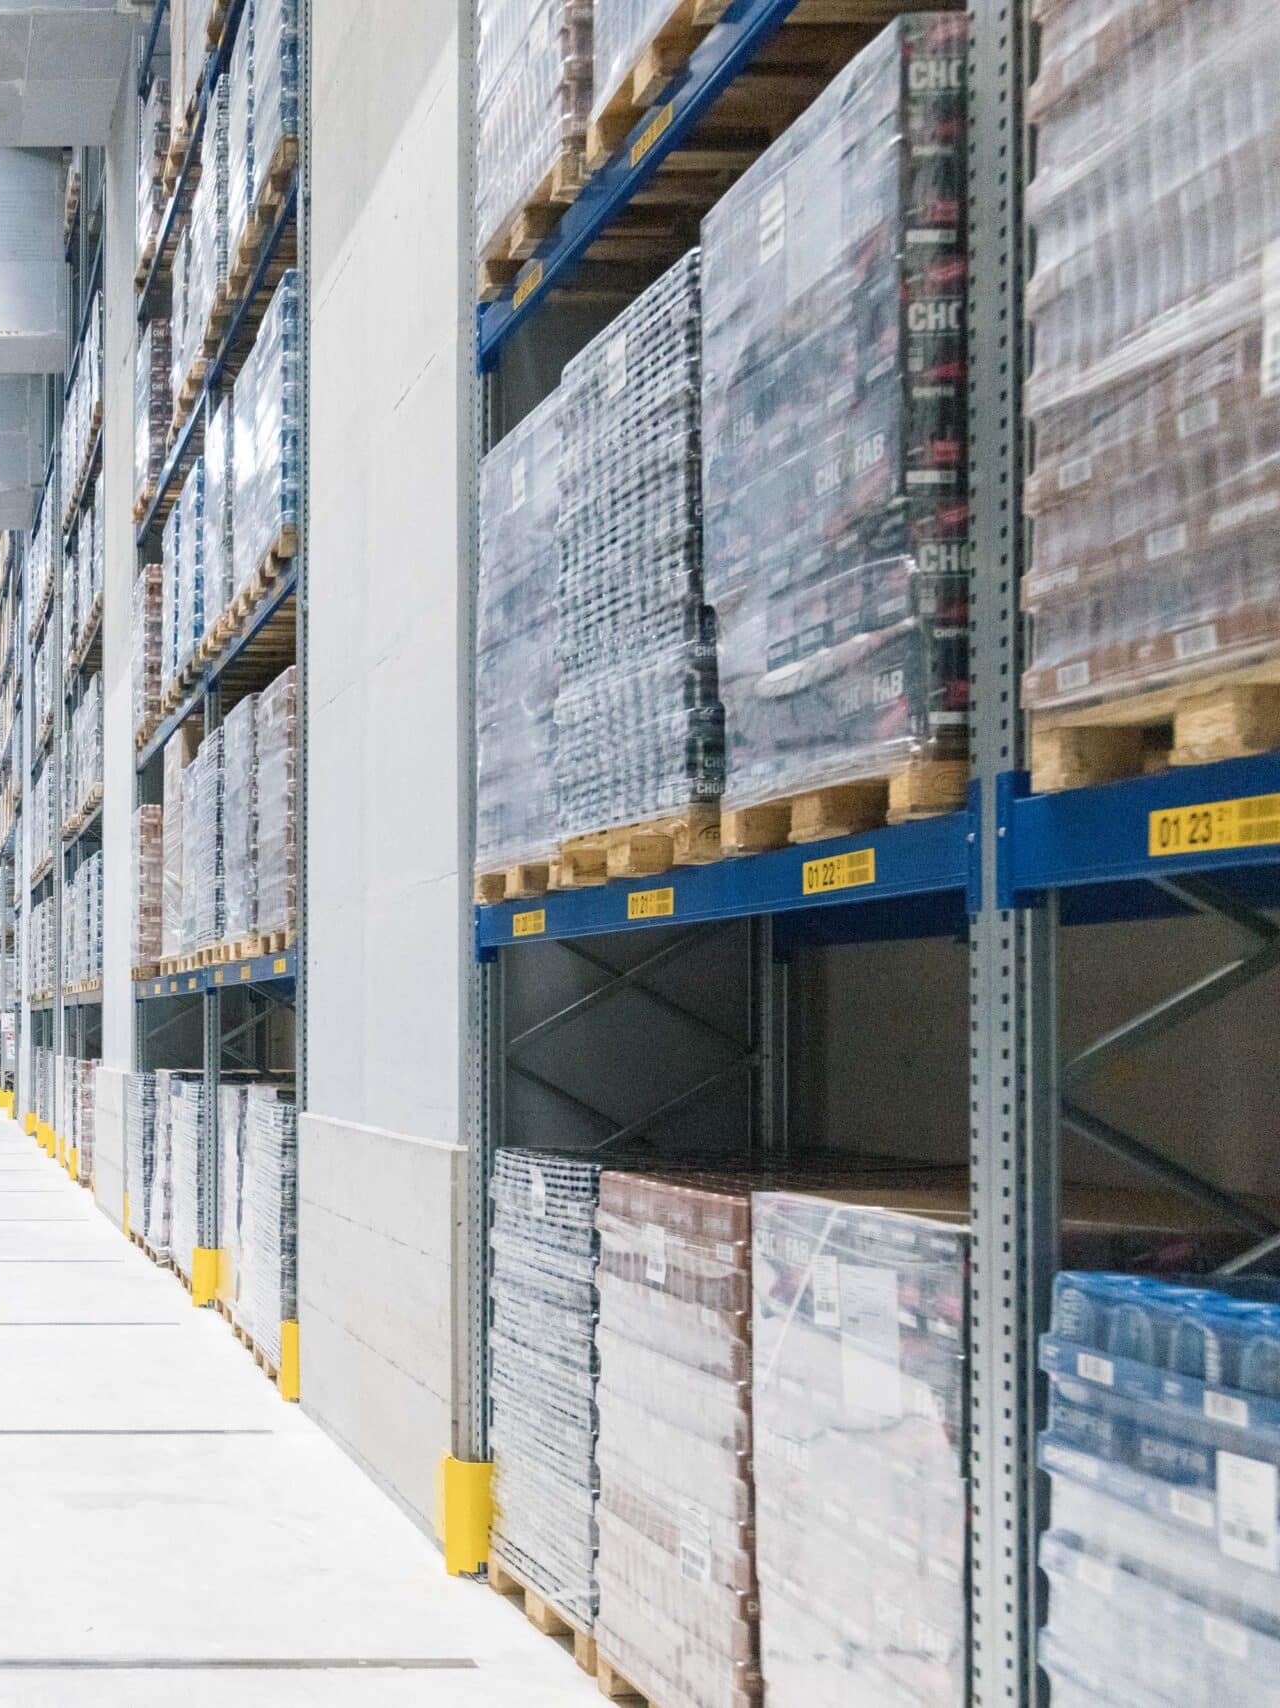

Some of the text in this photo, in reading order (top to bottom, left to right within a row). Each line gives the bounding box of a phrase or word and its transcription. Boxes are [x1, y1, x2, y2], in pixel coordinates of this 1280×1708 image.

[1160, 817, 1180, 848] 01
[1188, 811, 1212, 844] 23
[808, 866, 818, 889] 01
[823, 862, 834, 887] 22
